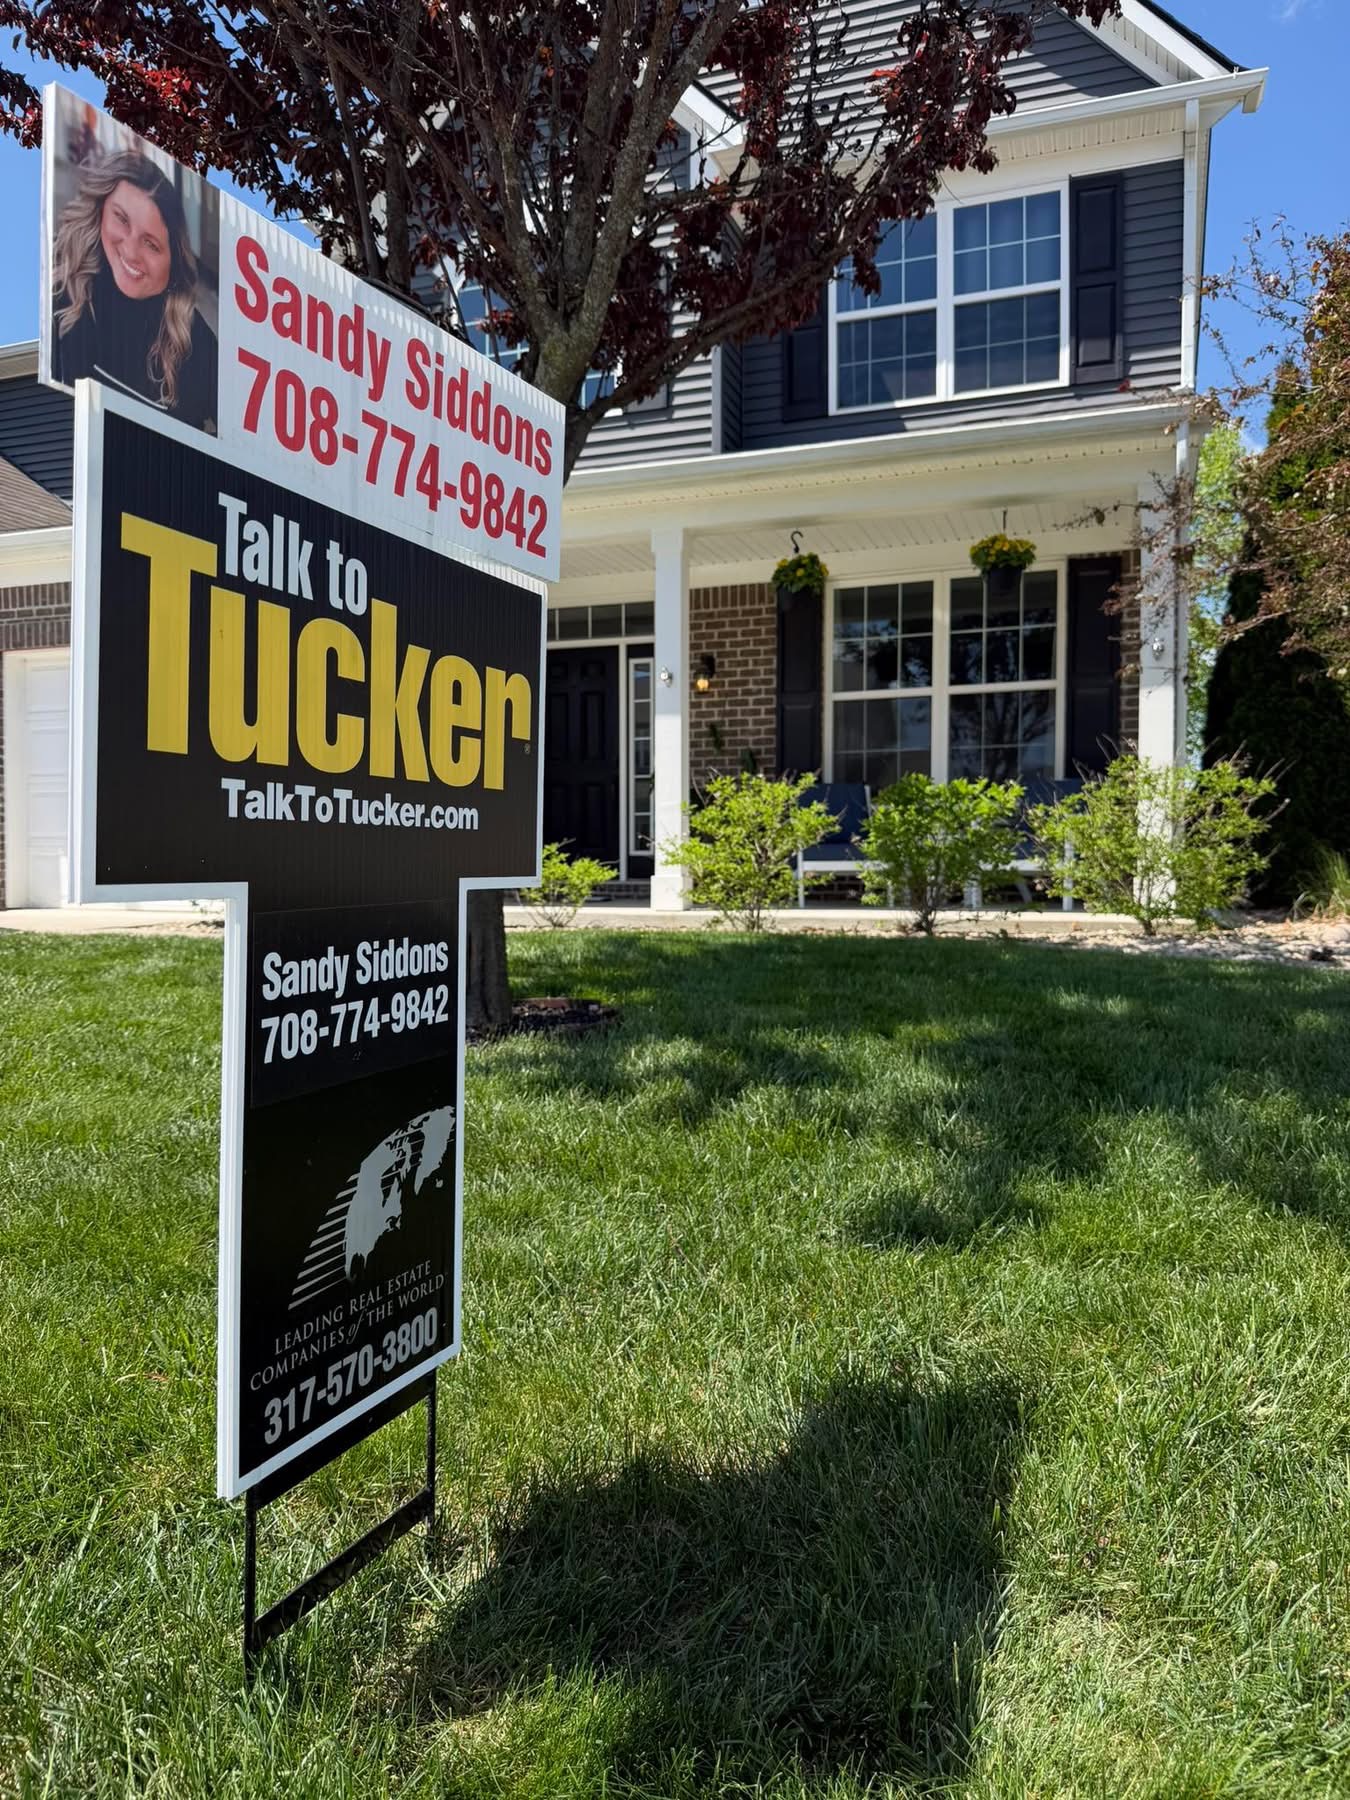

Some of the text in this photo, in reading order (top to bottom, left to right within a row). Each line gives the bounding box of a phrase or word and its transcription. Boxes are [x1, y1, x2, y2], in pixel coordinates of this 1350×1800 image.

[234, 235, 553, 476] Sandy Siddons
[238, 347, 547, 558] 708-774-9842
[218, 491, 368, 616] Talk to
[121, 511, 531, 790] Tucker
[221, 777, 479, 830] TalkToTucker.com
[261, 984, 449, 1064] 708-774-9842
[262, 937, 449, 1000] Sandy Siddons
[250, 1274, 444, 1391] COMPANIES of THE WORLD
[274, 1260, 431, 1355] LEADING REAL ESTATE
[264, 1306, 438, 1445] 317-570-3800
